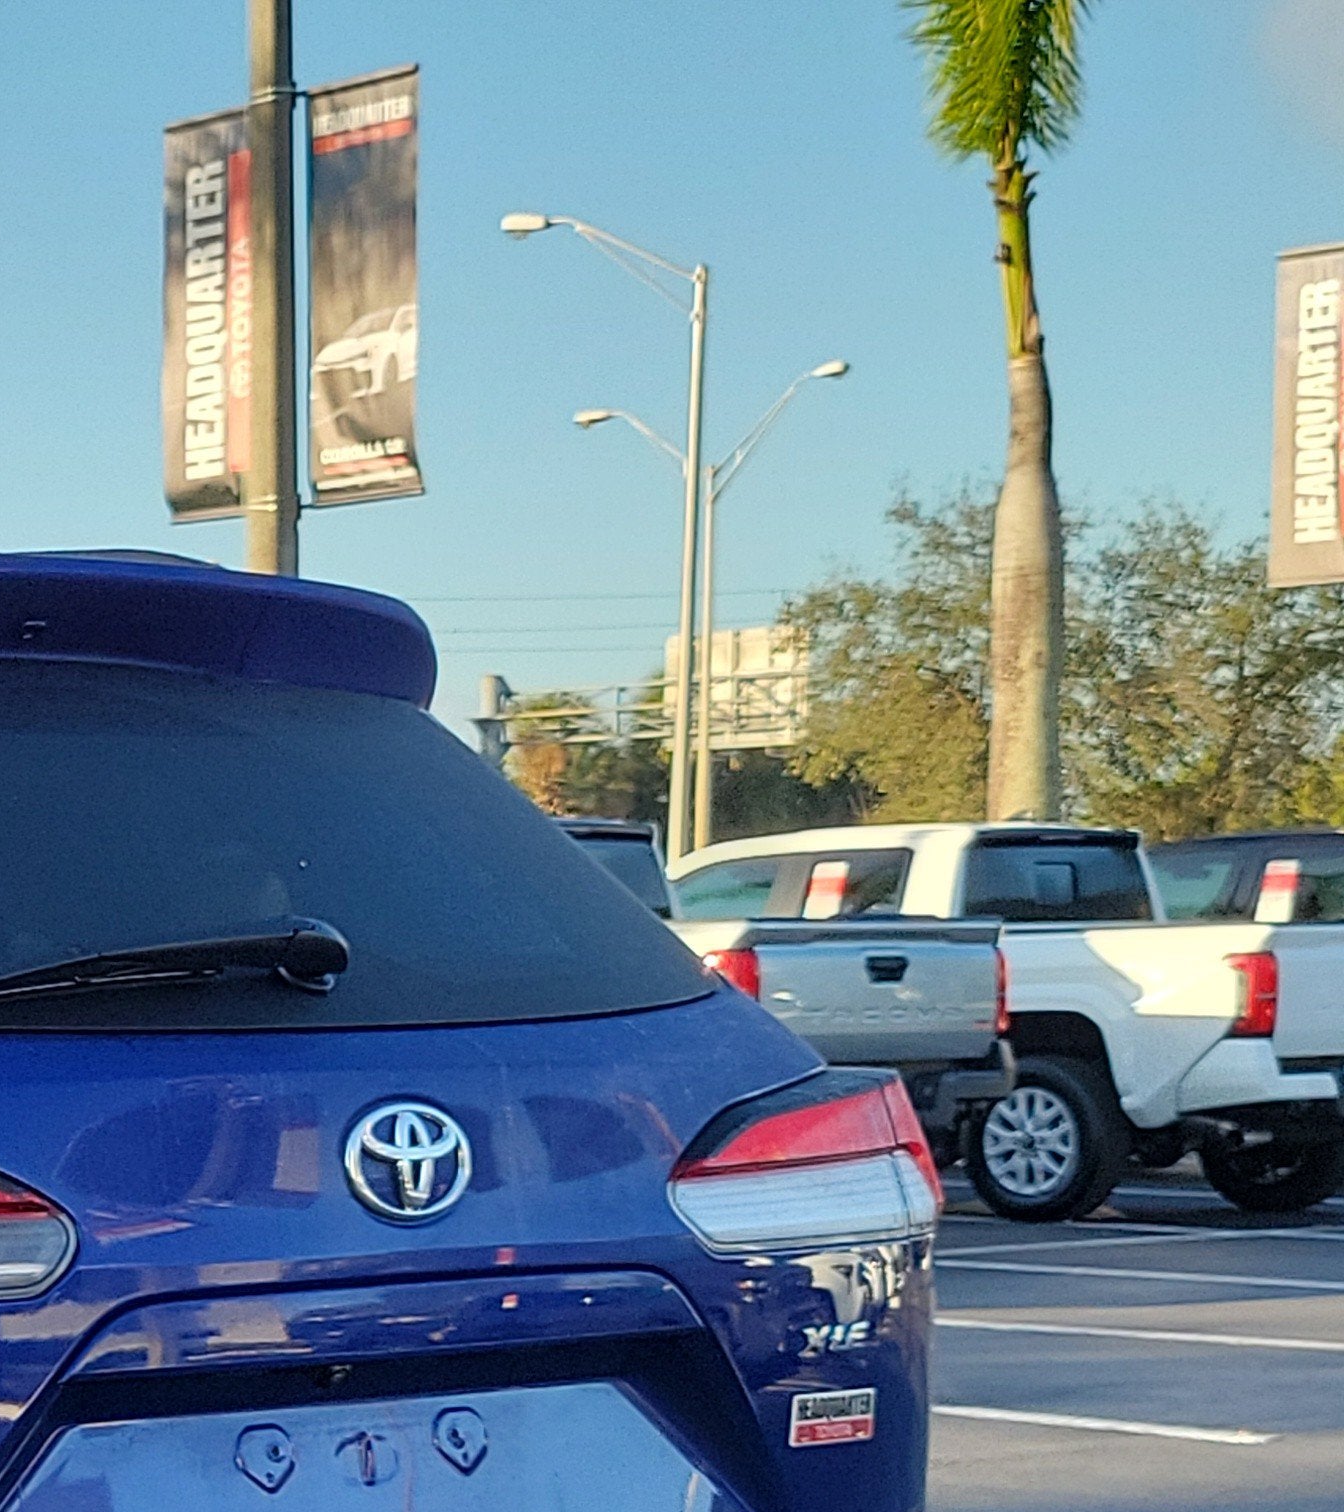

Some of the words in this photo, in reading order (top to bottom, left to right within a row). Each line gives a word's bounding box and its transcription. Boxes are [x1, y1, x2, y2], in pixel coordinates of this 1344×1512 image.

[185, 161, 225, 480] HEADQUARTER
[230, 236, 252, 359] TOYOTA
[1293, 278, 1339, 544] HEADQUARTER
